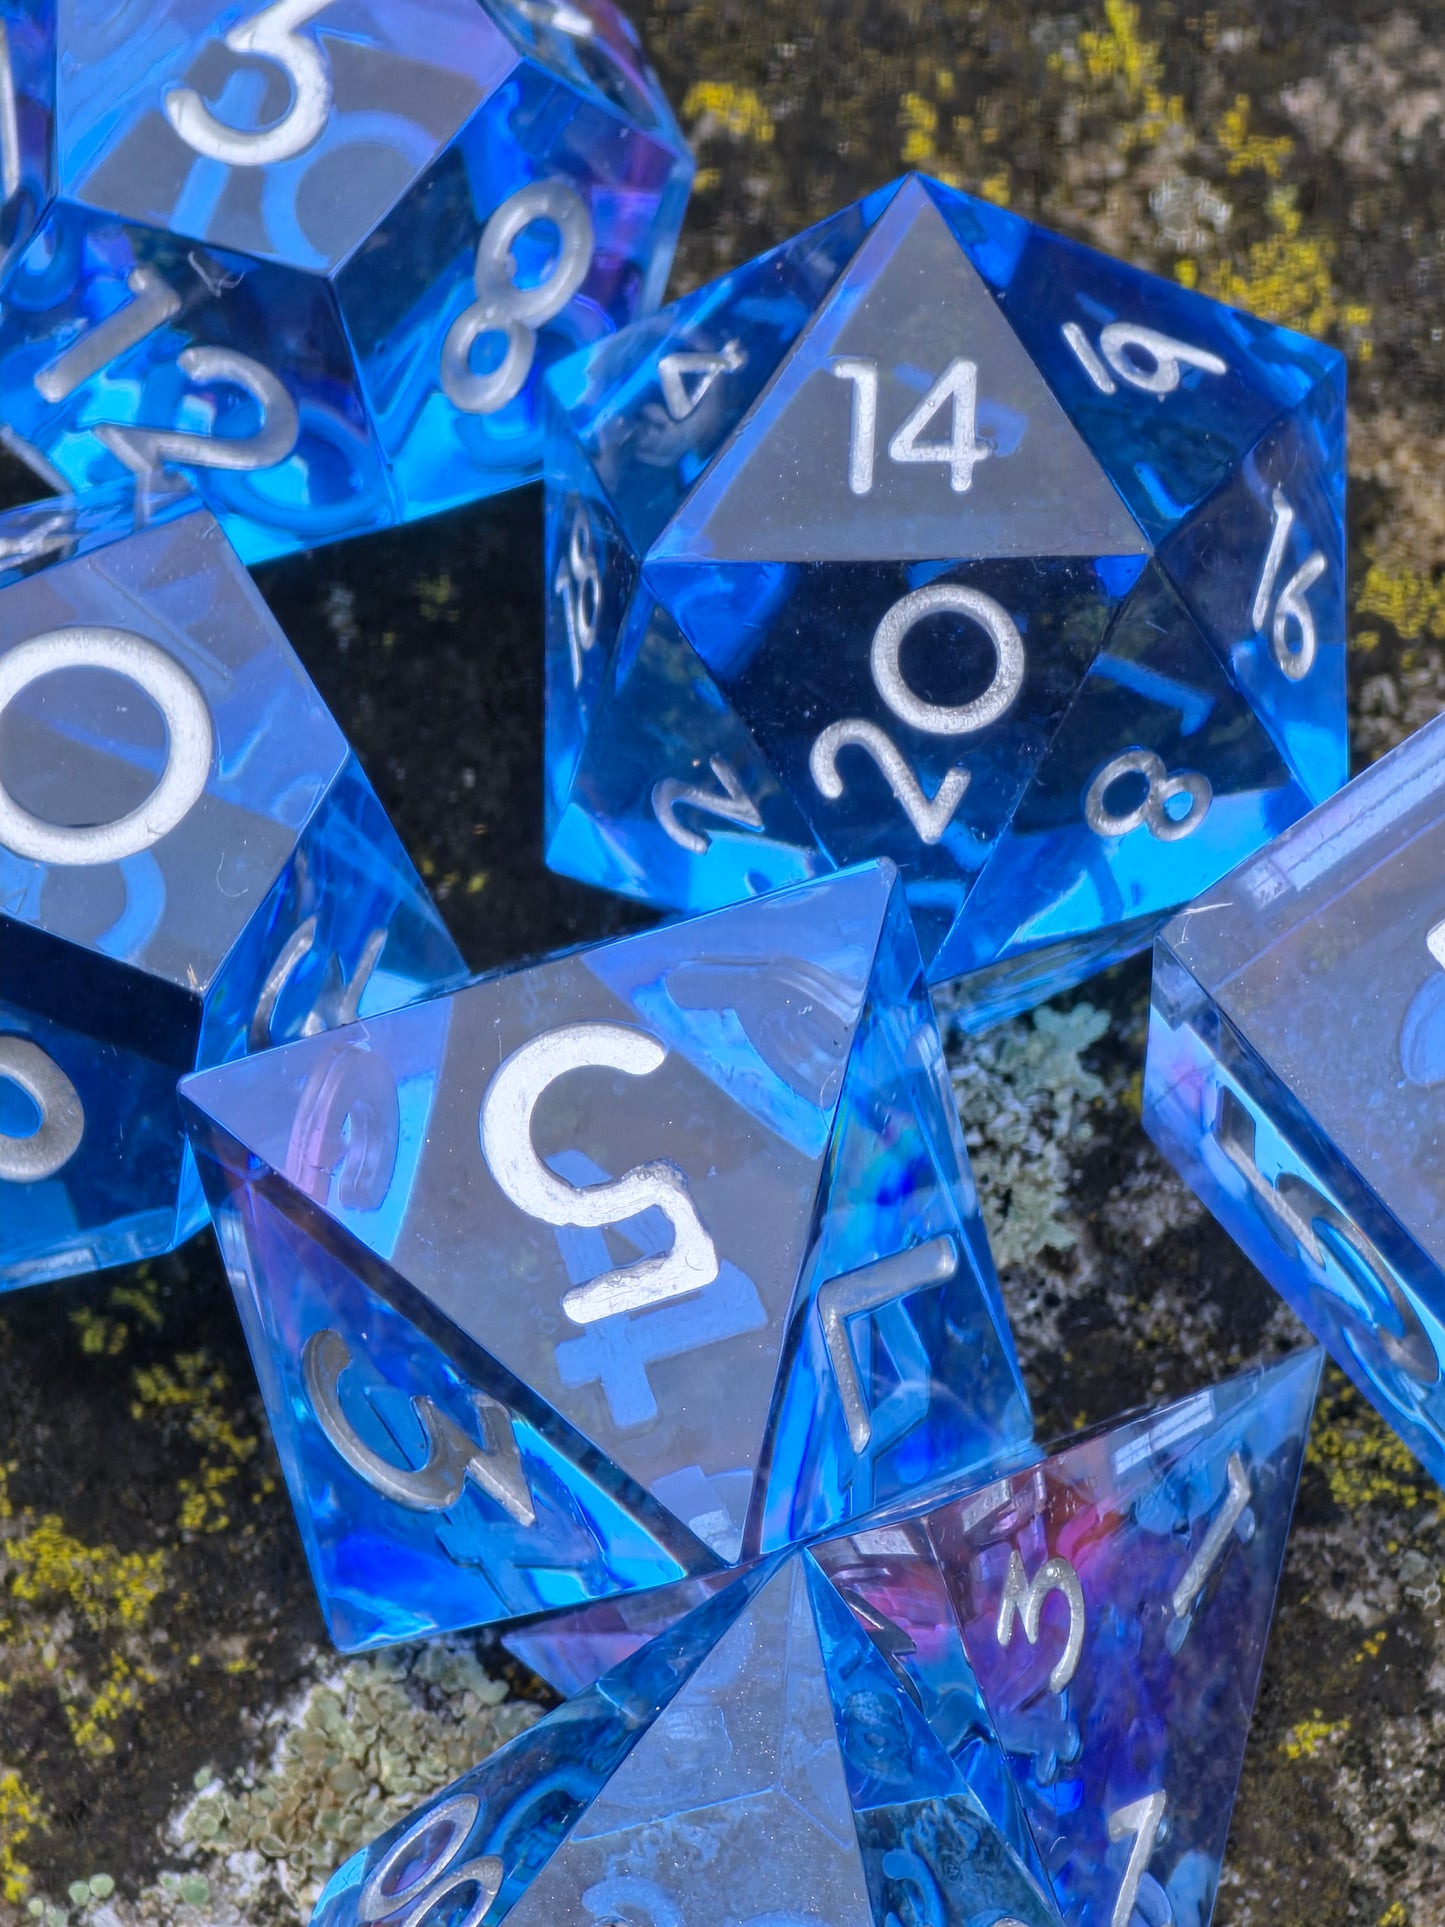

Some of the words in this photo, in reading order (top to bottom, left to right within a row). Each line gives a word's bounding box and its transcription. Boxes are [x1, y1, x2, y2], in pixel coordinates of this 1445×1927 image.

[440, 180, 595, 414] 8
[834, 356, 990, 494] 14
[1251, 486, 1326, 681] 16
[650, 754, 766, 855] 2
[808, 582, 1026, 845] 20
[1084, 746, 1214, 842] 8
[478, 1020, 721, 1326] 5
